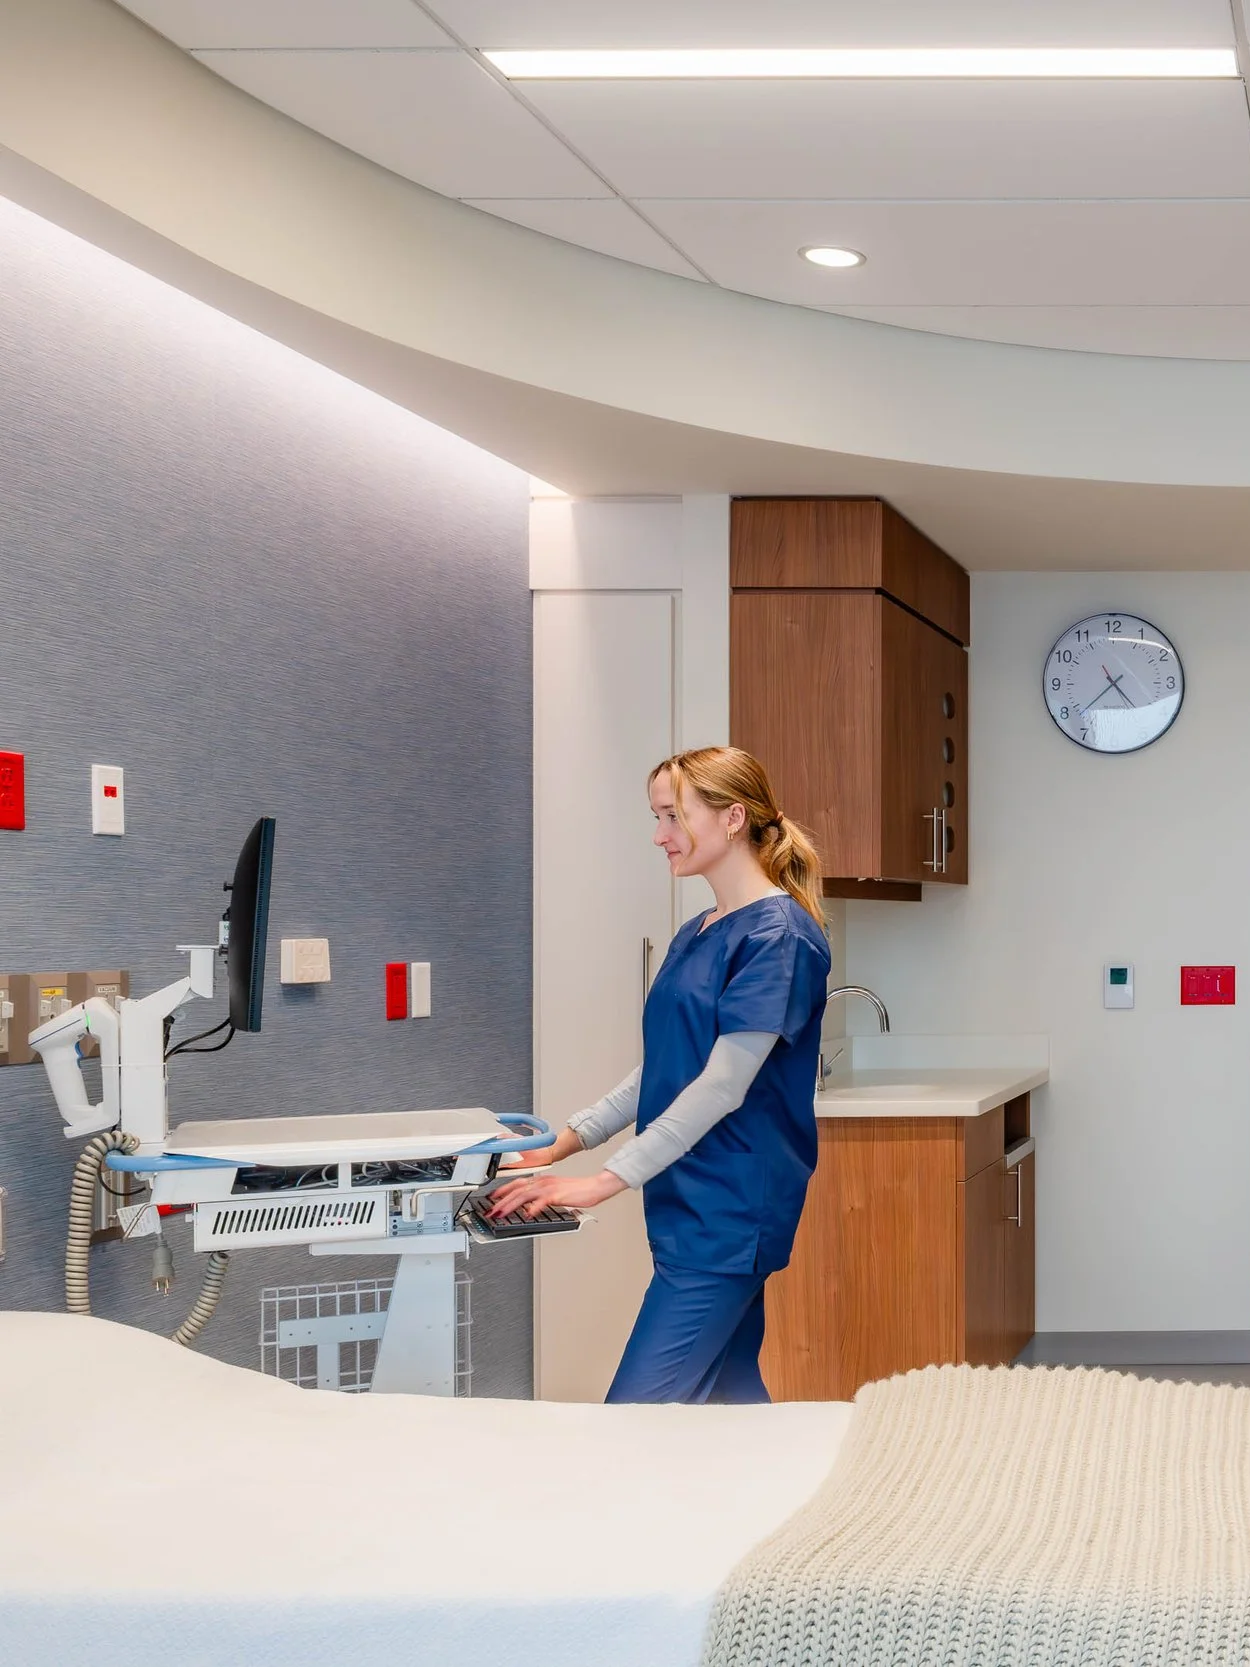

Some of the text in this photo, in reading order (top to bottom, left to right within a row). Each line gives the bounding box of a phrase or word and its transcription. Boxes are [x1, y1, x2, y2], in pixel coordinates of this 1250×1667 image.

[1105, 621, 1122, 633] 12
[1075, 630, 1089, 642] 11
[1138, 628, 1144, 640] 1
[1056, 650, 1072, 663] 10
[1160, 649, 1168, 661] 2
[1052, 678, 1061, 690] 9
[1167, 676, 1175, 689] 3
[1060, 707, 1069, 719] 8
[1080, 728, 1088, 740] 7
